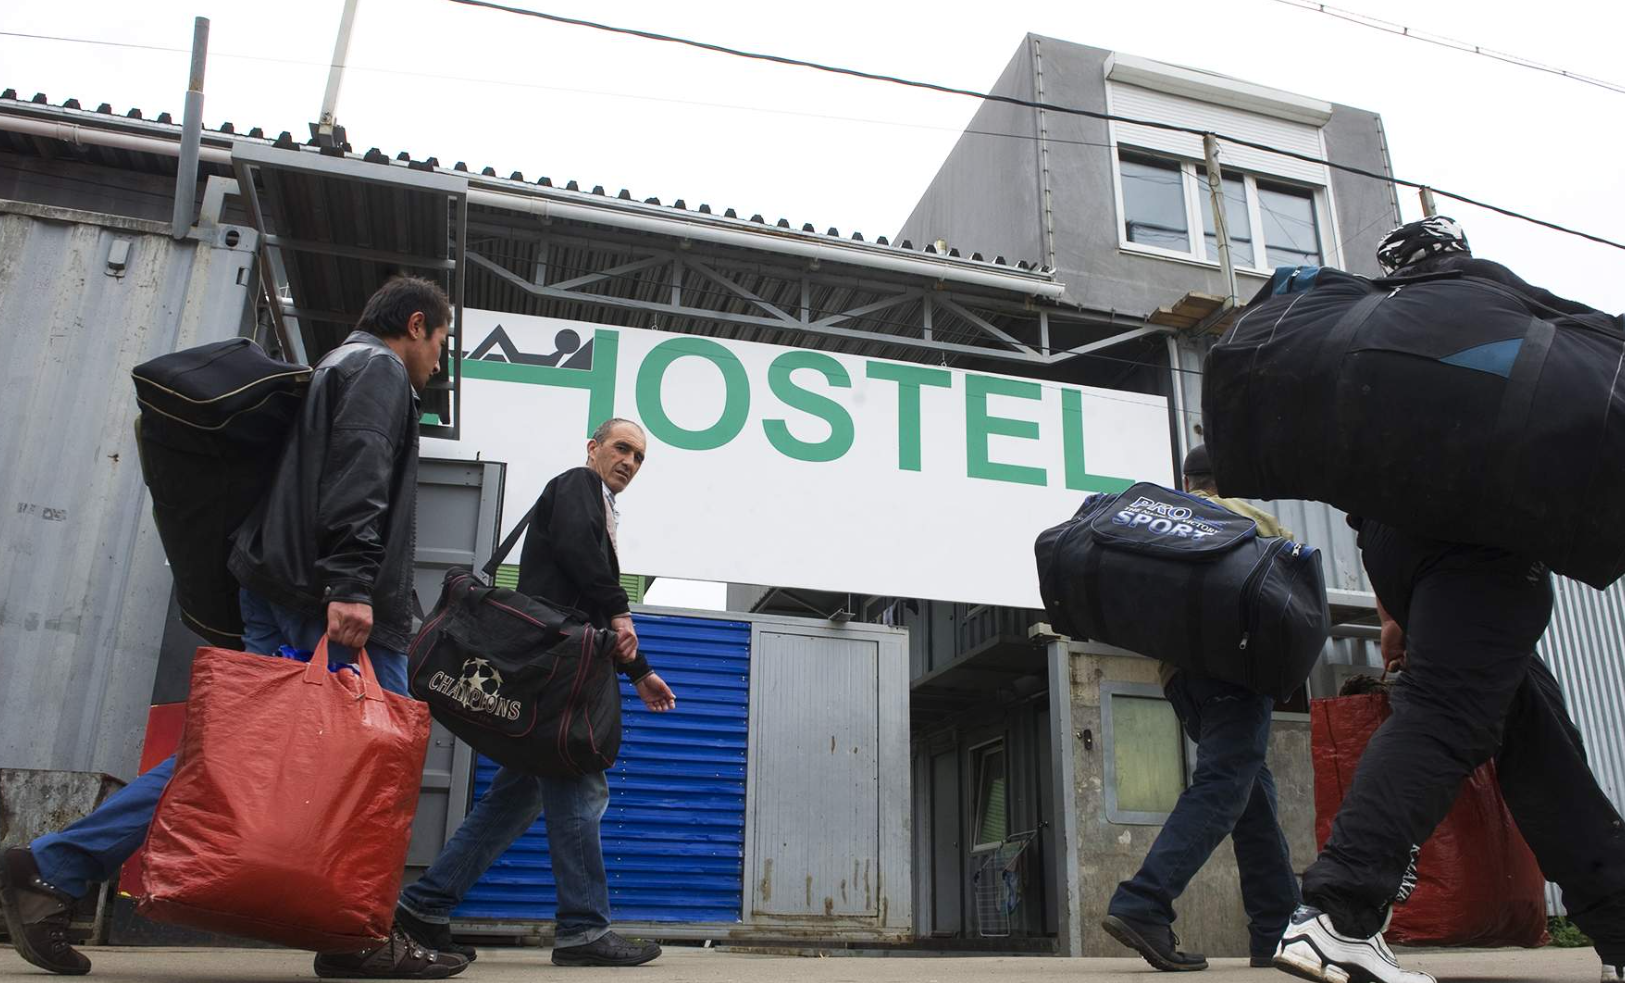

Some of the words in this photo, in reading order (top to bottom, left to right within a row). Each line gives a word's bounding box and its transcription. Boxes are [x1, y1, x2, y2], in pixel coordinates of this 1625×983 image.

[1129, 497, 1193, 520] PRO
[1112, 510, 1215, 542] SPORT
[428, 670, 522, 720] CHAMPIONS
